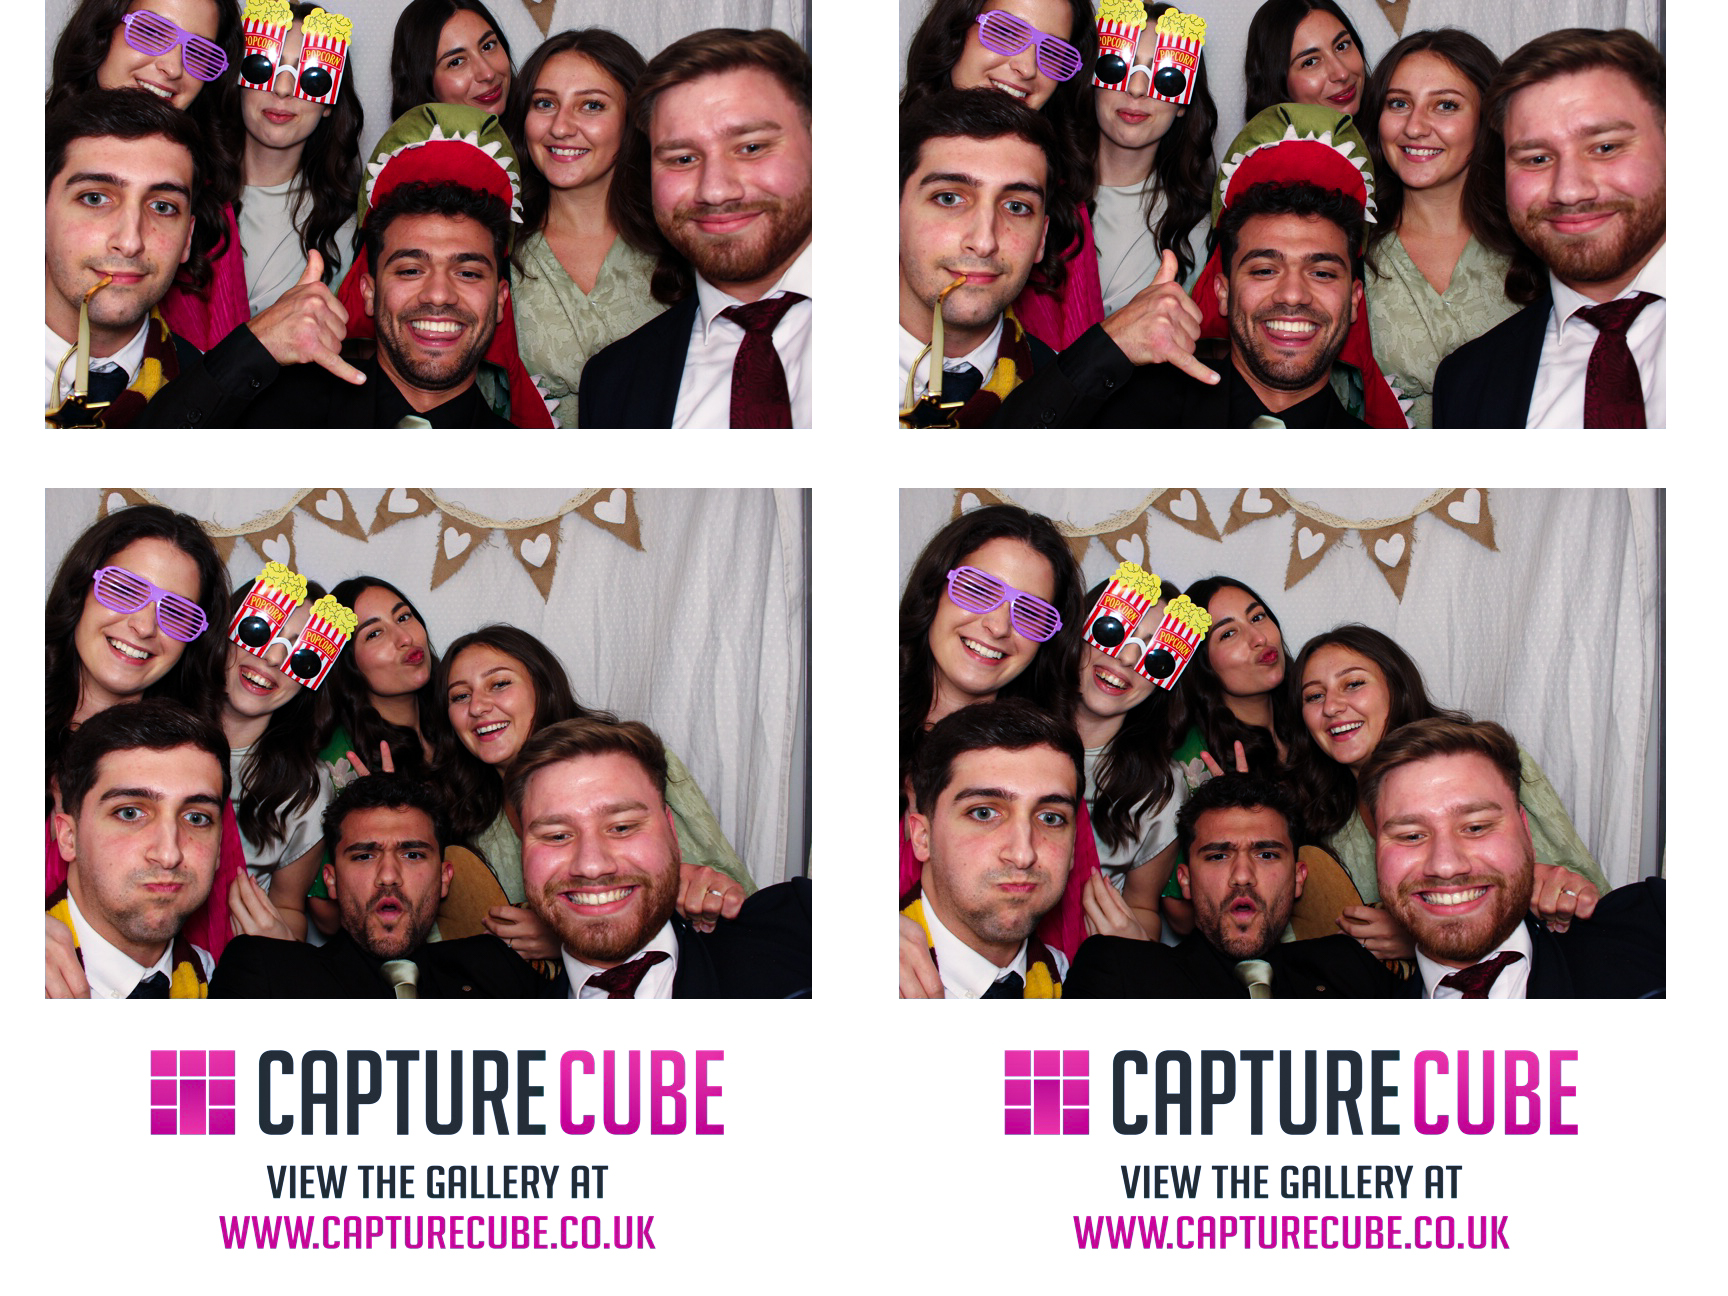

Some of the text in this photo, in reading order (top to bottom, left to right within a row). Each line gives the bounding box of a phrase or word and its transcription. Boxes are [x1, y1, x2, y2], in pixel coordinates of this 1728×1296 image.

[305, 49, 342, 67] POPCORN
[1159, 49, 1196, 67] POPCORN
[250, 595, 285, 622] POPCORN
[1104, 595, 1139, 622] POPCORN
[305, 631, 337, 657] POPCORN
[1159, 631, 1191, 657] POPCORN
